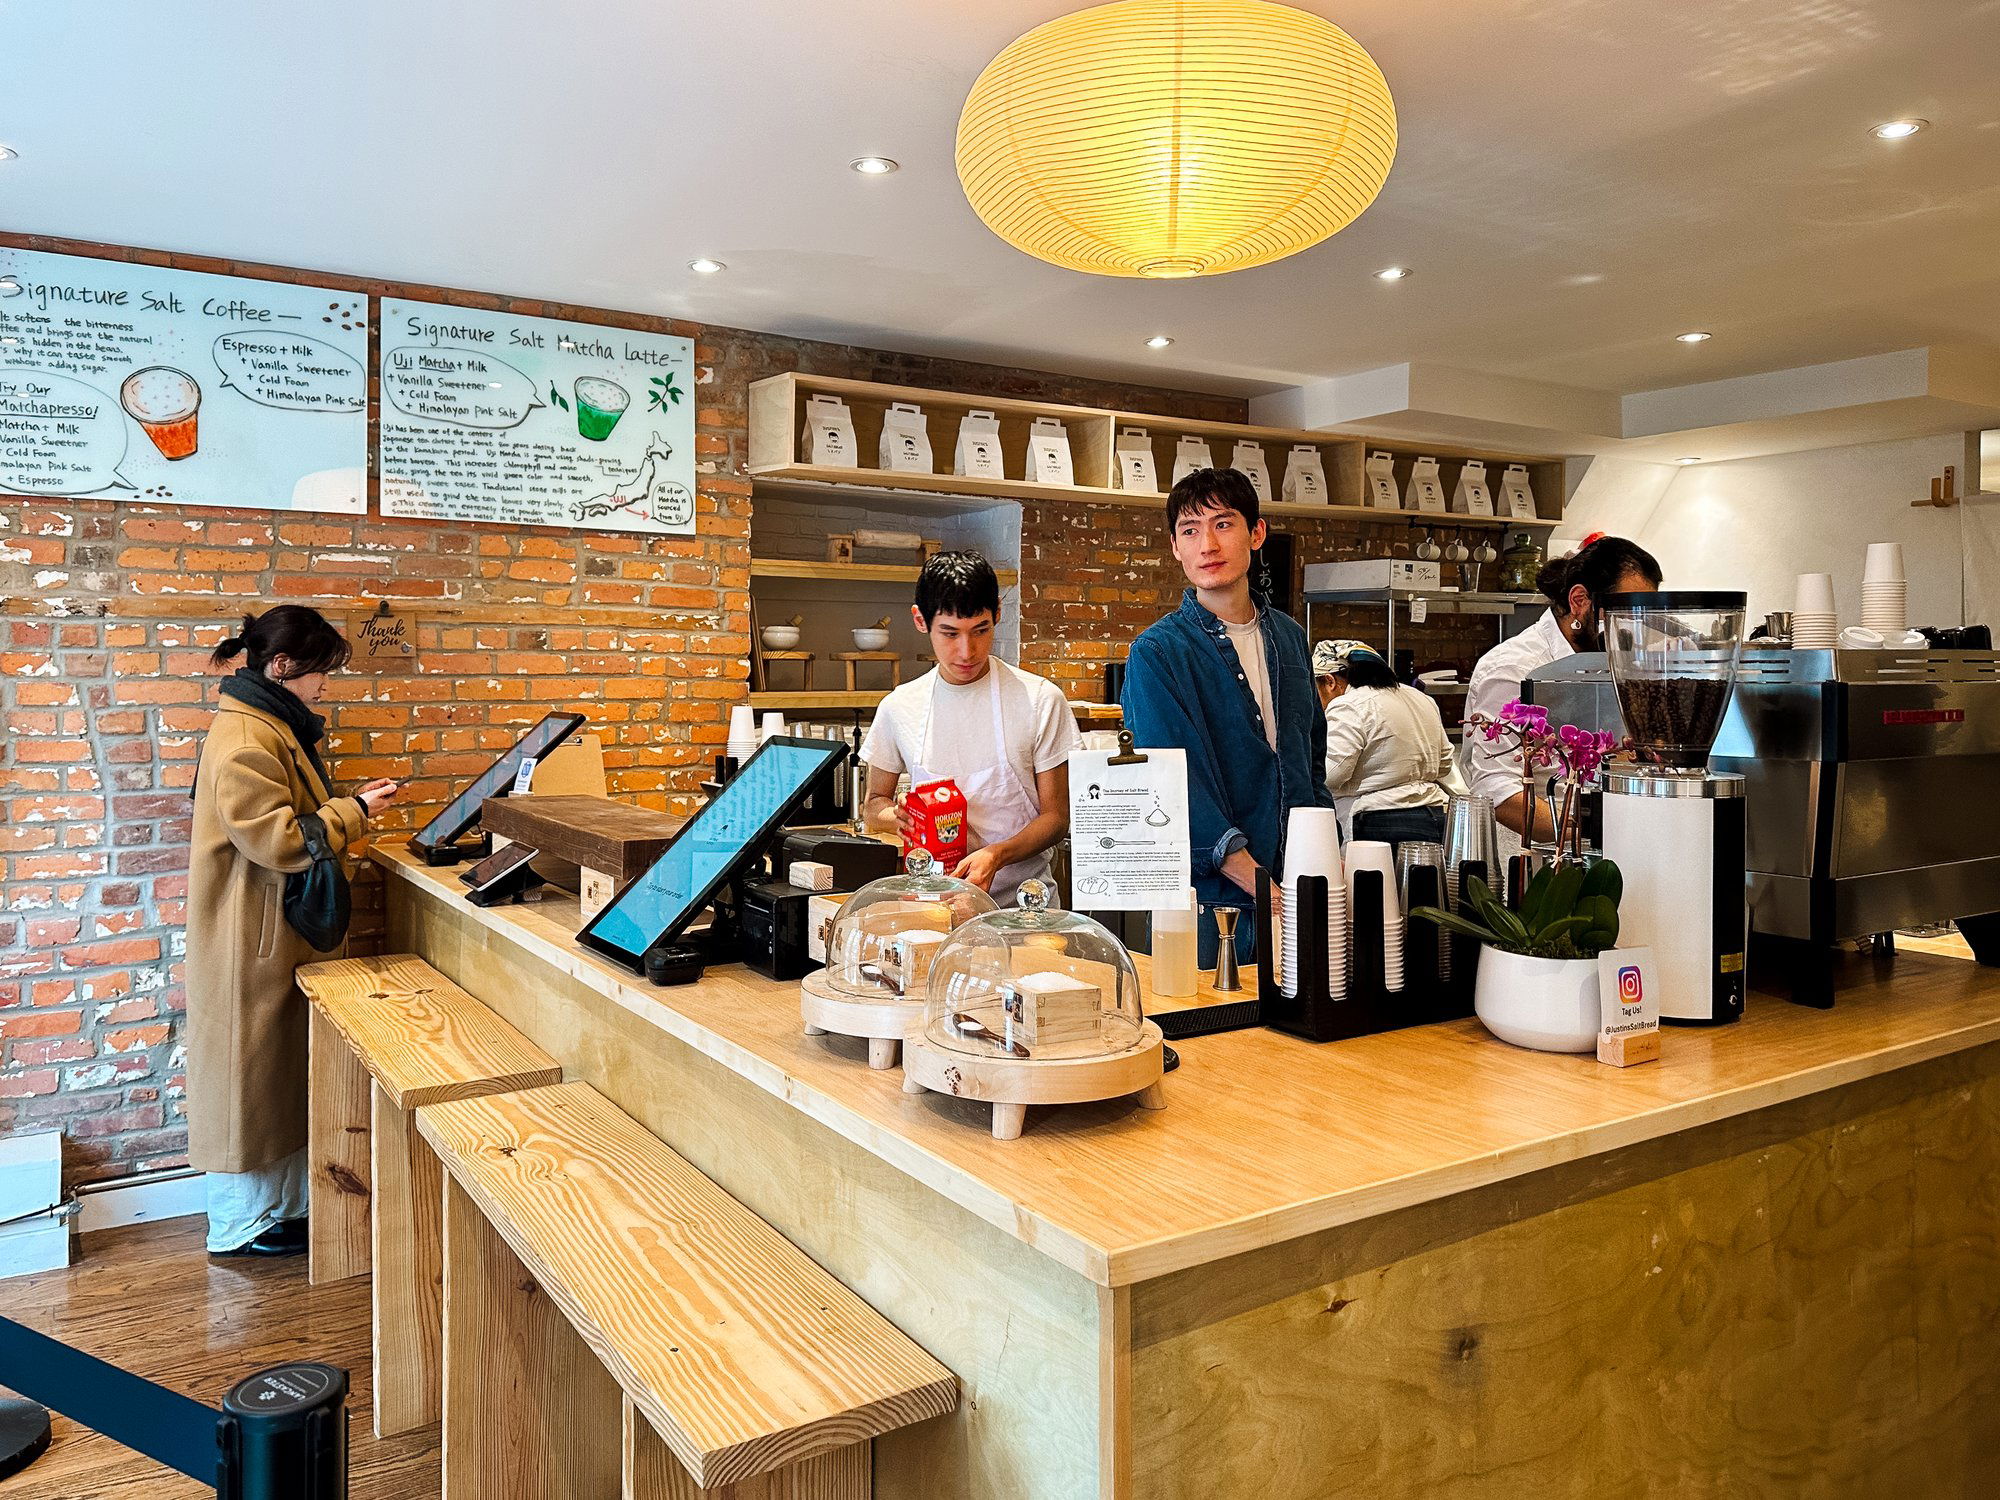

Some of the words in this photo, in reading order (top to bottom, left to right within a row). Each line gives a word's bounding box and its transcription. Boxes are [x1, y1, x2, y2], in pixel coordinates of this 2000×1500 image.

[0, 275, 128, 310] Signature
[140, 290, 185, 313] Salt
[202, 298, 271, 322] Coffee
[64, 318, 81, 327] the
[85, 319, 134, 331] bitterness
[25, 325, 42, 334] and
[47, 327, 73, 340] brings
[76, 331, 92, 339] out
[97, 332, 114, 341] the
[119, 336, 153, 345] natural
[407, 316, 495, 347] Signature
[508, 328, 544, 349] Salt
[557, 334, 614, 360] Matcha
[32, 337, 62, 348] hidden
[76, 341, 91, 350] the
[222, 338, 276, 356] Espresso
[292, 345, 313, 356] Milk
[14, 347, 32, 358] why
[47, 350, 63, 358] can
[67, 351, 96, 360] taste
[48, 360, 77, 373] adding
[251, 358, 288, 370] Vanilla
[296, 363, 351, 377] Sweetener
[393, 353, 413, 367] Uji
[418, 355, 455, 370] Matcha
[467, 360, 487, 372] Milk
[259, 374, 280, 384] Cold
[284, 376, 309, 387] Foam
[397, 374, 433, 386] Vanilla
[438, 377, 487, 391] Sweetener
[26, 382, 51, 395] Our
[409, 390, 429, 399] Cold
[434, 391, 456, 401] Foam
[266, 388, 322, 404] Himalayan
[325, 393, 345, 405] Pink
[0, 399, 98, 419] Matchapresso!
[419, 402, 469, 417] Himalayan
[499, 408, 518, 419] Salt
[56, 423, 79, 434] Milk
[0, 434, 36, 445] Vanilla
[6, 448, 28, 457] Cold
[33, 448, 56, 457] Foam
[48, 461, 67, 471] Pink
[18, 475, 64, 487] Espresso
[357, 614, 406, 638] Thank
[369, 636, 400, 656] you
[1621, 1008, 1631, 1017] Tag
[1632, 1006, 1642, 1015] Us!
[1605, 1019, 1657, 1035] @JustinsSaltBread
